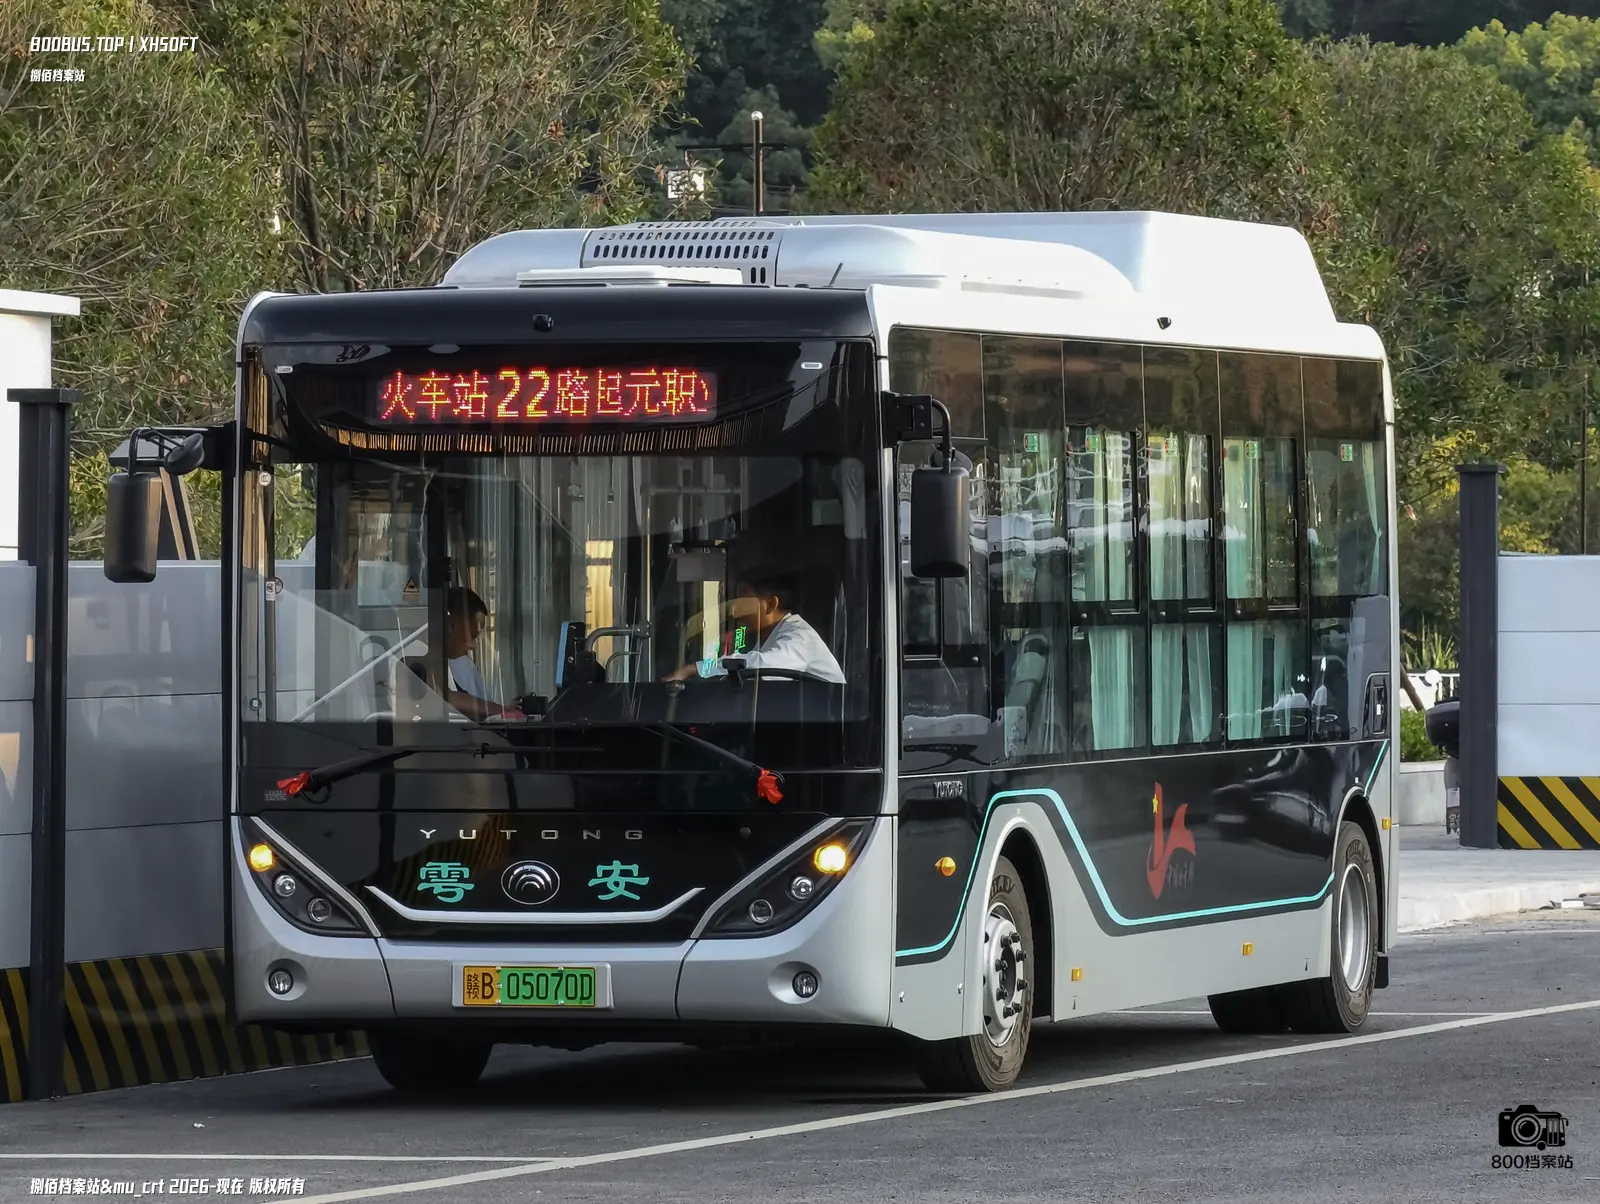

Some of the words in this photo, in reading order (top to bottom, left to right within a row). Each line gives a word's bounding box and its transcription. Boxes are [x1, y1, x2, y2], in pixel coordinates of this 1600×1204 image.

[419, 828, 644, 841] YUTONG
[587, 860, 650, 901] 安
[506, 972, 593, 1001] 05070D
